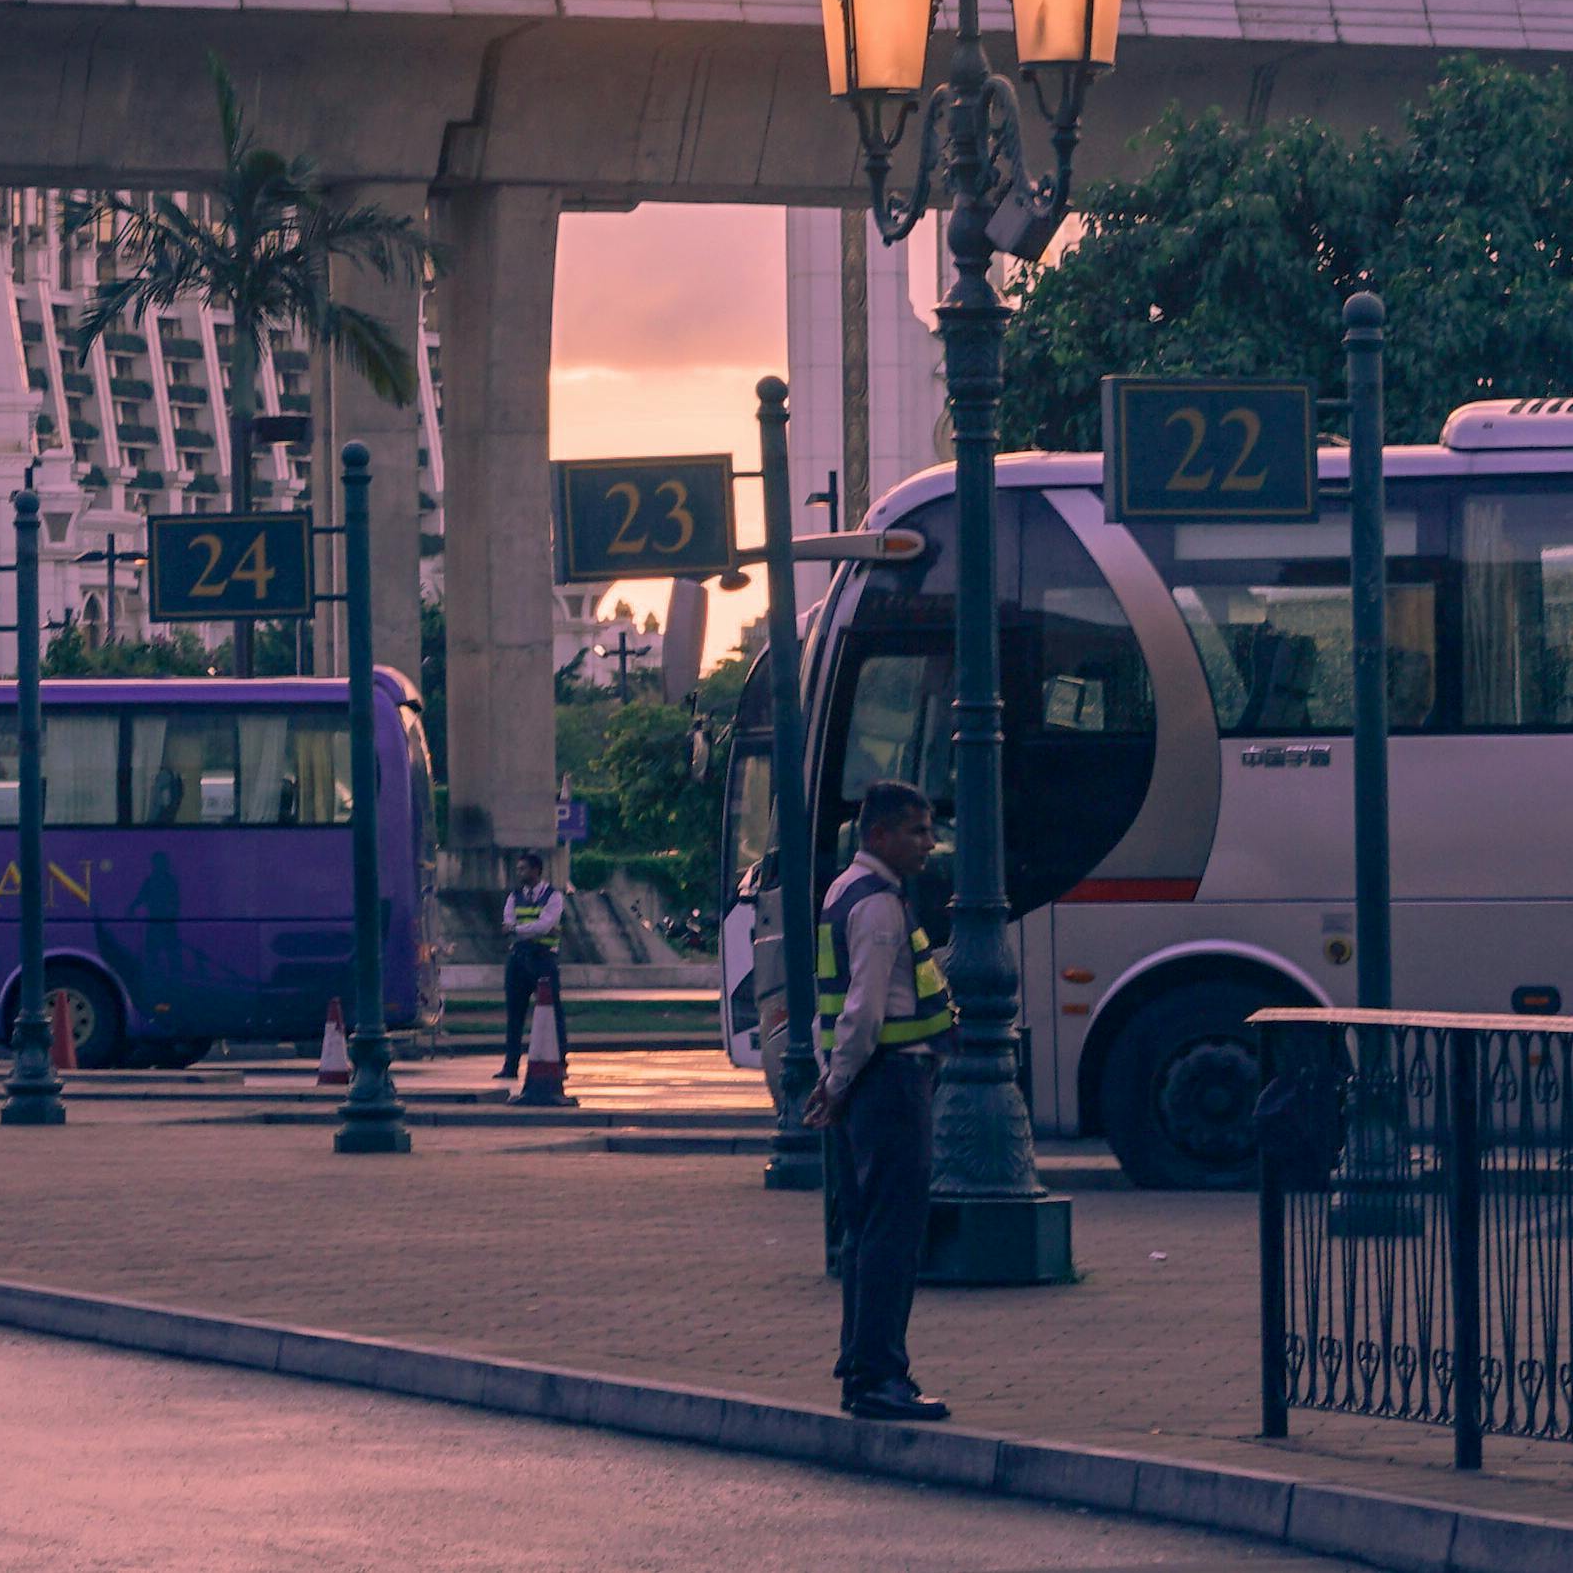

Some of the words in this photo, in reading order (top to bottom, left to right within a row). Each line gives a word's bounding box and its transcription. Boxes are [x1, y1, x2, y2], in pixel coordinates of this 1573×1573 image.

[1164, 407, 1269, 492] 22
[605, 479, 693, 555] 23
[188, 531, 276, 600] 24
